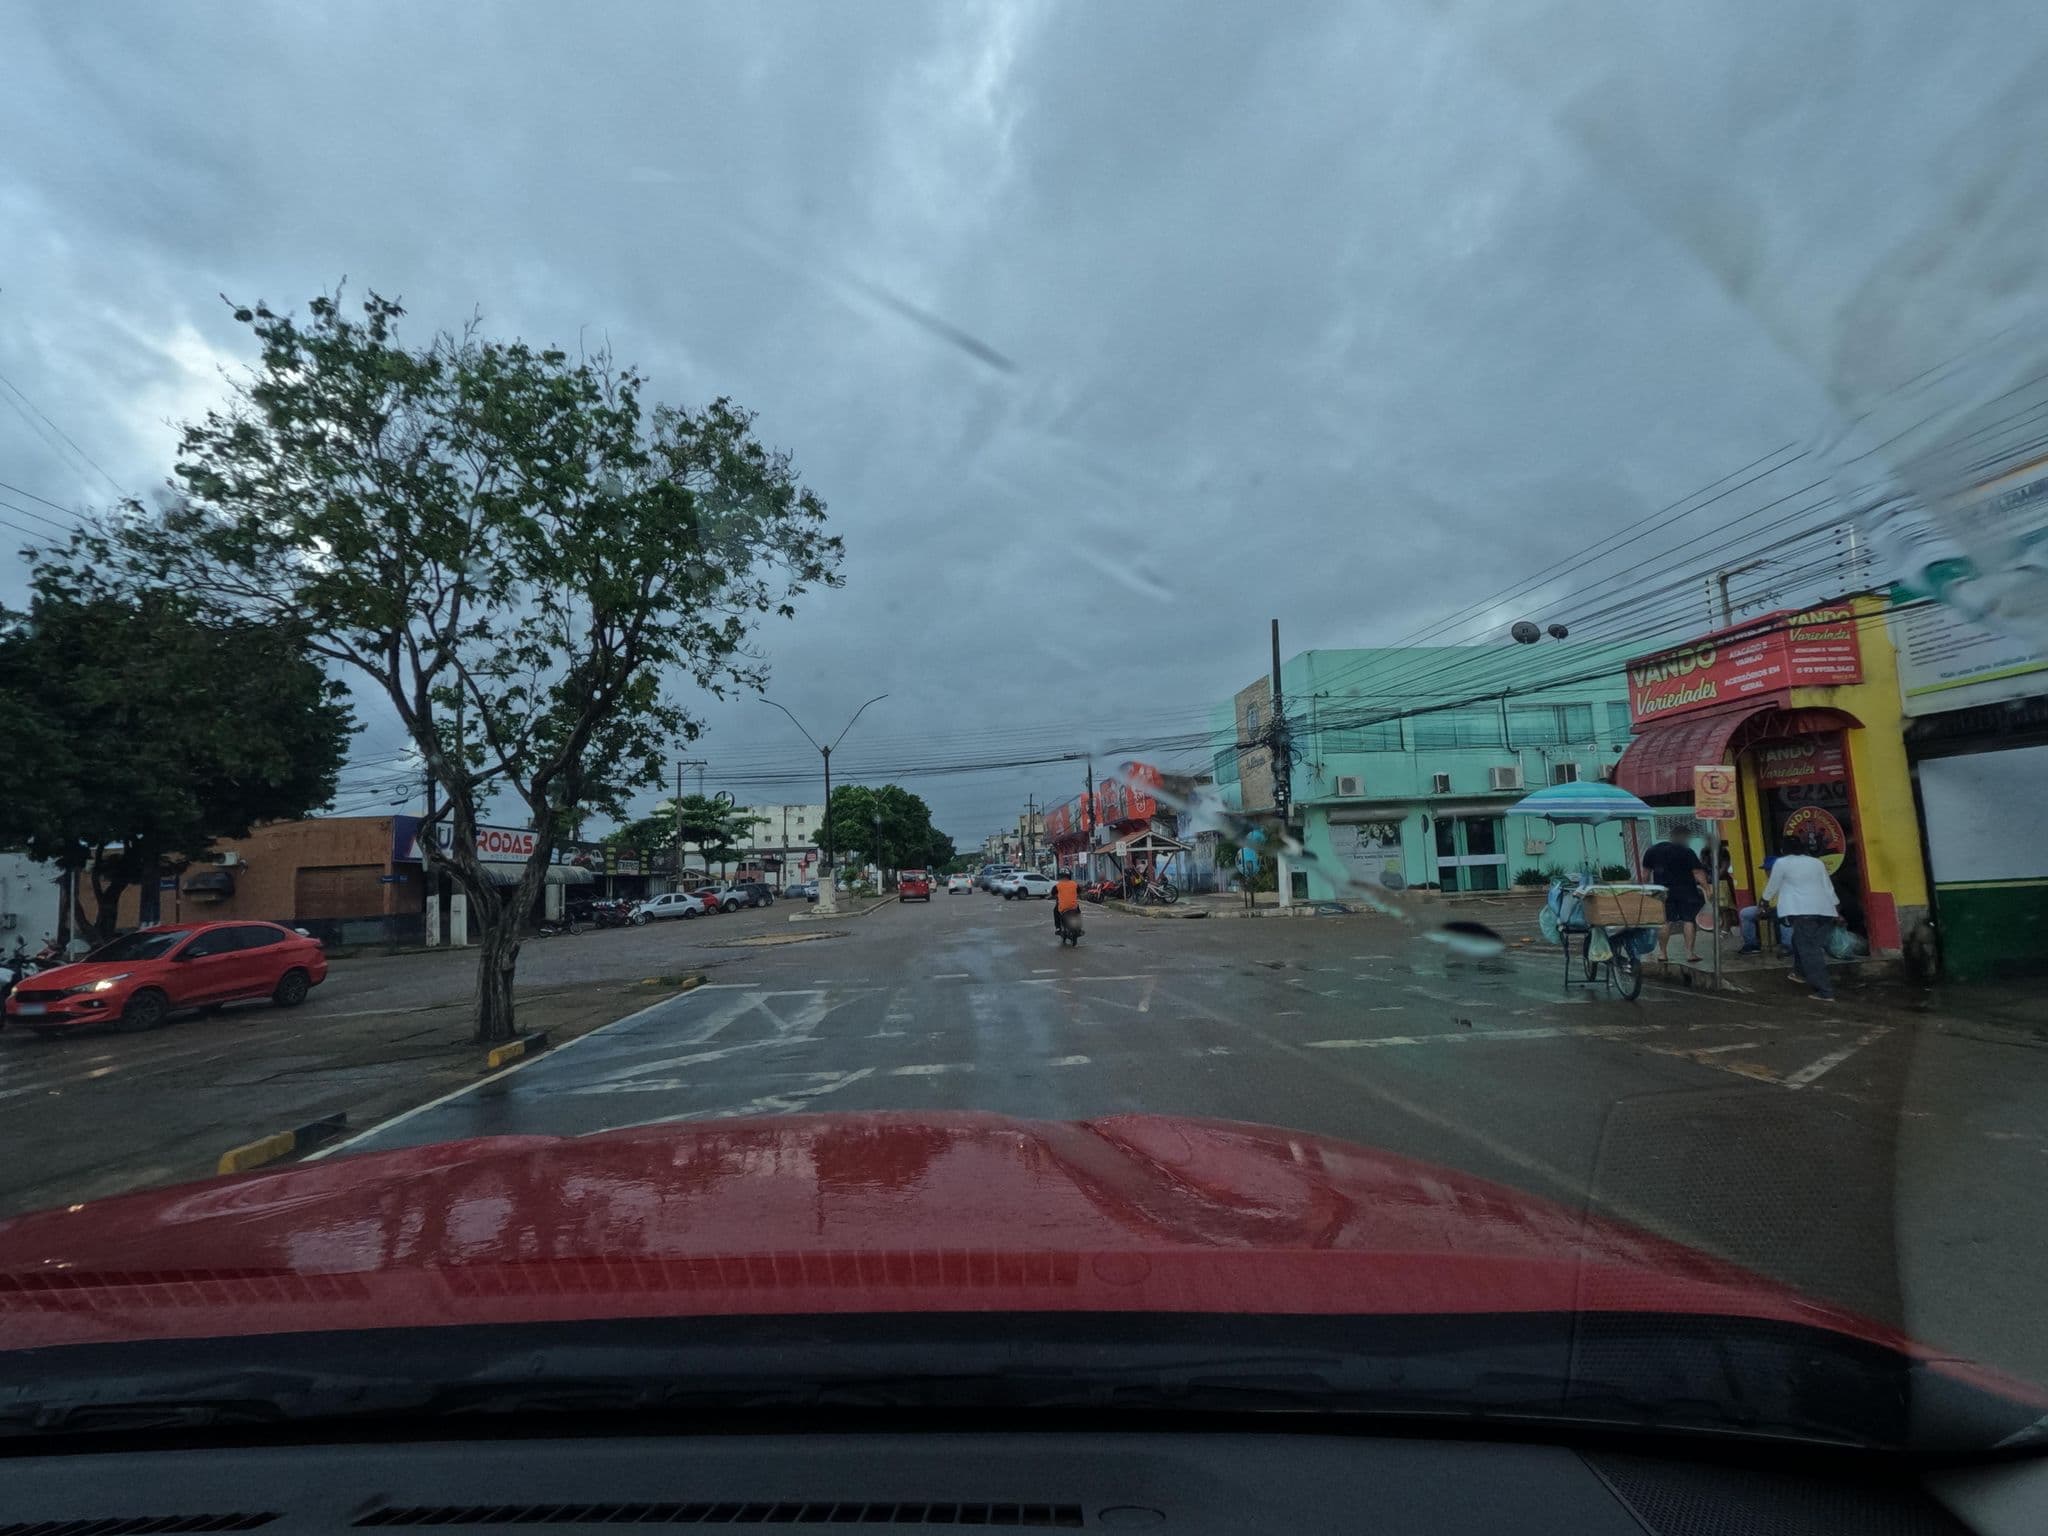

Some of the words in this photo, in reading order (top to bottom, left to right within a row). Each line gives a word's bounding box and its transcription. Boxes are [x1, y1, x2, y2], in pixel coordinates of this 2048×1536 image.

[1787, 611, 1850, 626] VANDO
[1790, 628, 1851, 641] Variedades
[1632, 643, 1717, 688] VANDO
[1637, 677, 1718, 715] Variedades
[476, 831, 533, 854] RODAS
